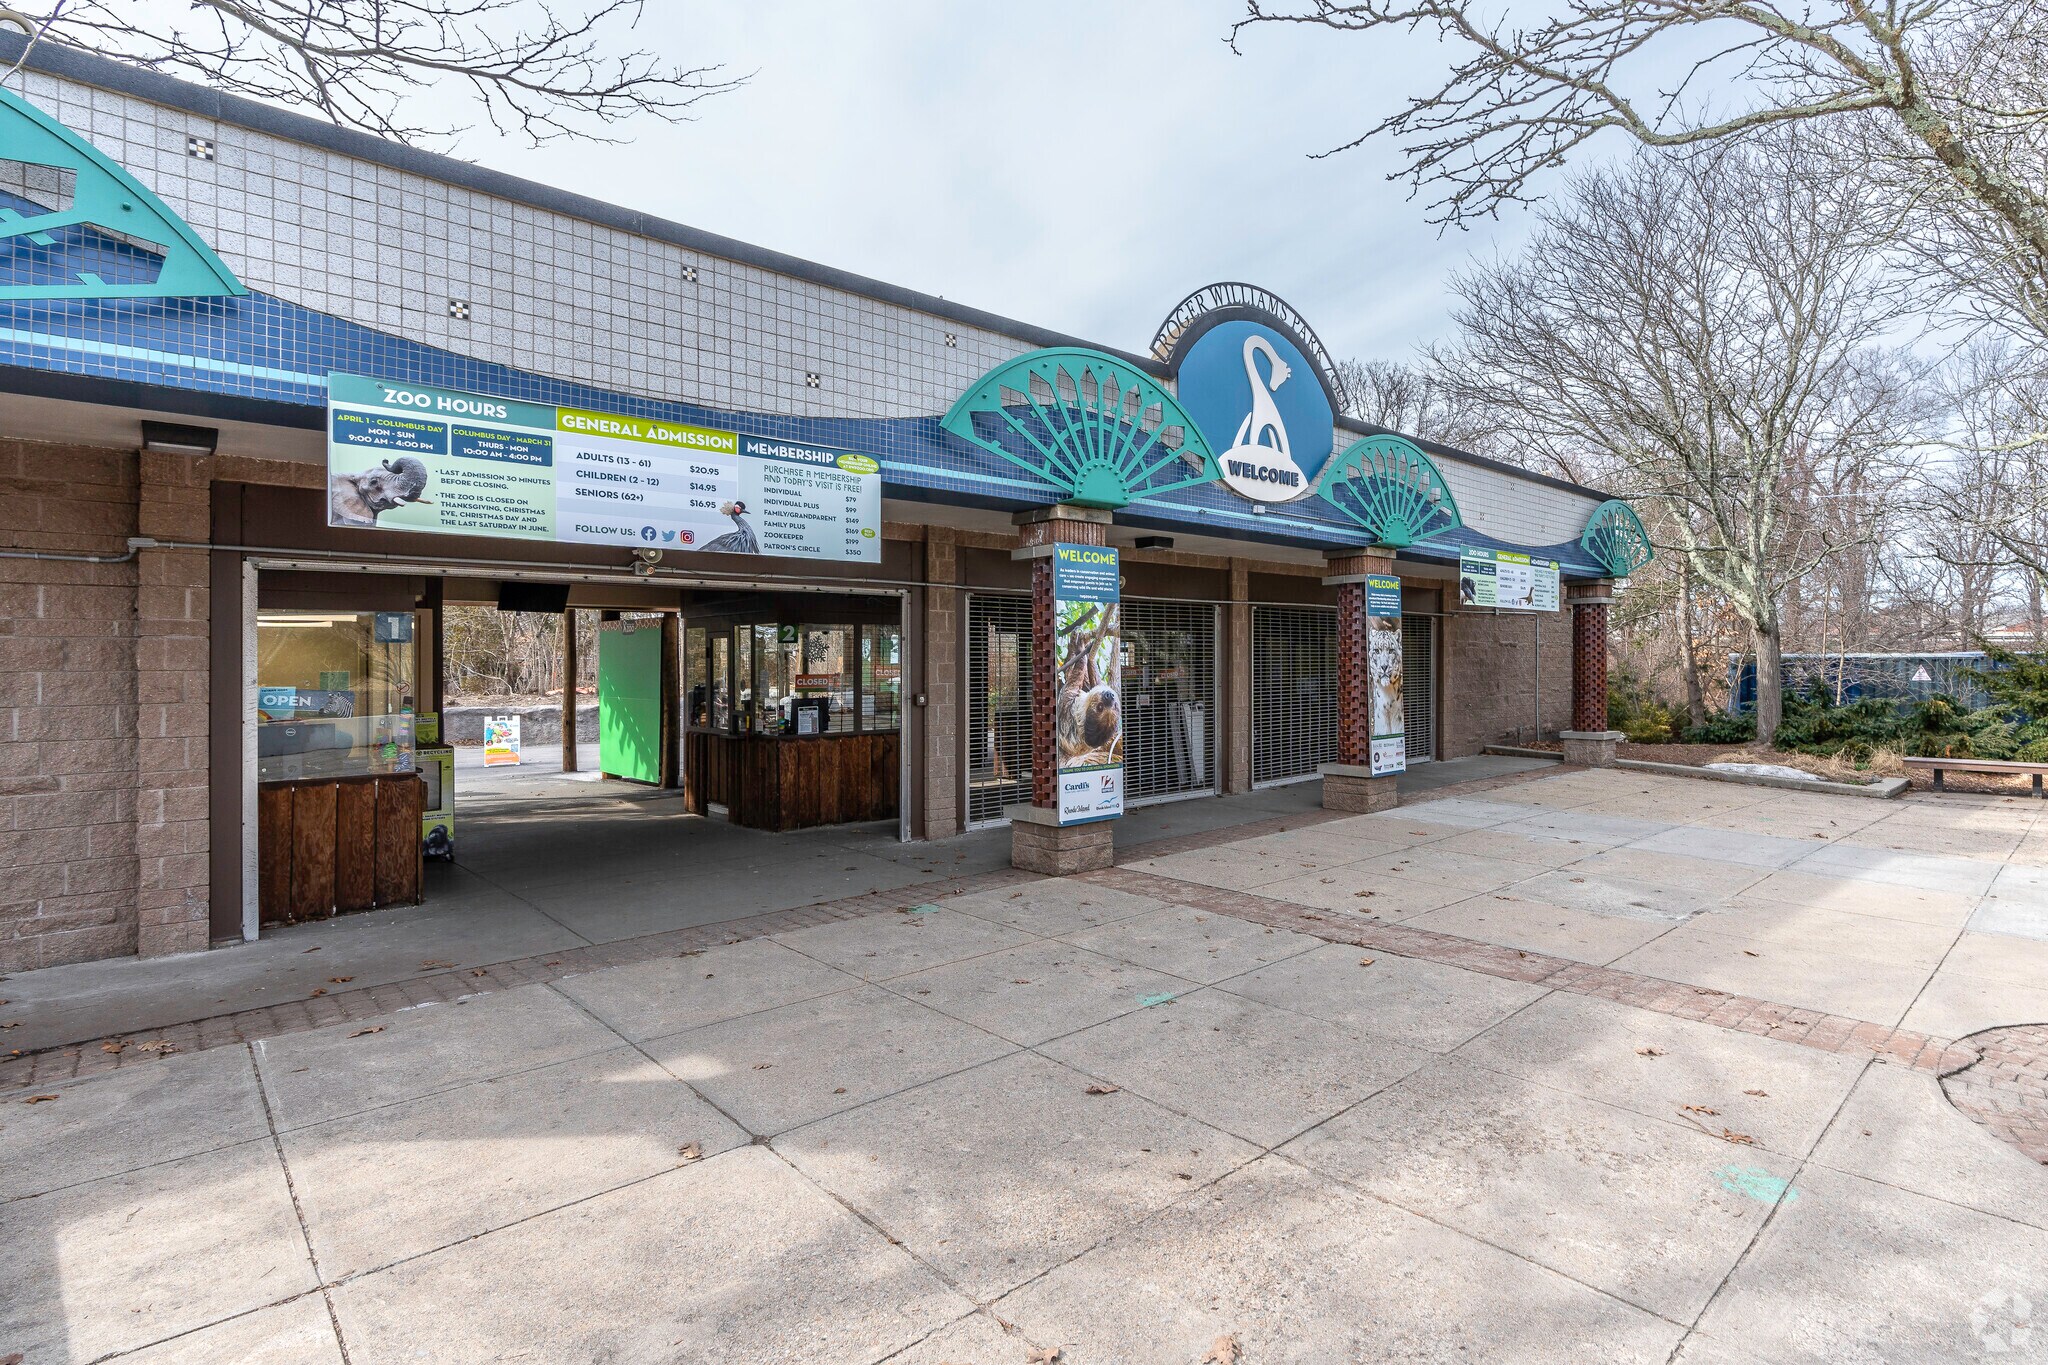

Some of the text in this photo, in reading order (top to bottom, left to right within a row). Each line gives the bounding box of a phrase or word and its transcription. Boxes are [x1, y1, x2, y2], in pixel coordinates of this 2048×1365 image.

[1157, 293, 1210, 353] ROGER
[1208, 284, 1288, 320] WILLIAMS
[1291, 314, 1324, 366] PARK
[383, 389, 508, 418] ZOO HOURS
[338, 415, 364, 423] APRIL
[377, 419, 425, 430] COLUMBUS
[453, 429, 495, 439] COLUMBUS
[516, 437, 542, 446] MARCH
[562, 415, 732, 450] GENERAL ADMISSION
[478, 441, 504, 449] THURS
[747, 442, 834, 463] MEMBERSHIP
[576, 452, 614, 463] ADULTS
[617, 456, 630, 465] (13
[638, 459, 651, 468] 61)
[462, 472, 504, 480] ADMISSION
[690, 465, 719, 476] $20.95
[764, 465, 803, 476] PURCHASE
[814, 472, 861, 484] MEMBERSHIP
[1228, 459, 1299, 487] WELCOME
[441, 478, 509, 490] BEFORE CLOSING.
[576, 470, 626, 482] CHILDREN
[629, 476, 638, 484] (2
[647, 478, 659, 486] 12)
[764, 475, 780, 483] AND
[844, 484, 862, 493] FREE!
[690, 482, 716, 492] $14.95
[764, 487, 802, 496] INDIVIDUAL
[575, 488, 643, 501] SENIORS (62+)
[690, 499, 716, 509] $16.95
[764, 498, 802, 508] INDIVIDUAL
[460, 512, 503, 520] CHRISTMAS
[504, 507, 545, 515] CHRISTMAS
[764, 510, 836, 522] FAMILY/GRANDPARENT
[479, 521, 517, 529] SATURDAY
[576, 525, 617, 534] FOLLOW
[764, 532, 804, 540] ZOOKEEPER
[1058, 549, 1116, 565] WELCOME
[1369, 579, 1399, 589] WELCOME
[388, 617, 399, 639] 1
[782, 625, 795, 641] 2
[263, 695, 311, 706] OPEN
[1065, 782, 1089, 790] Cardi's
